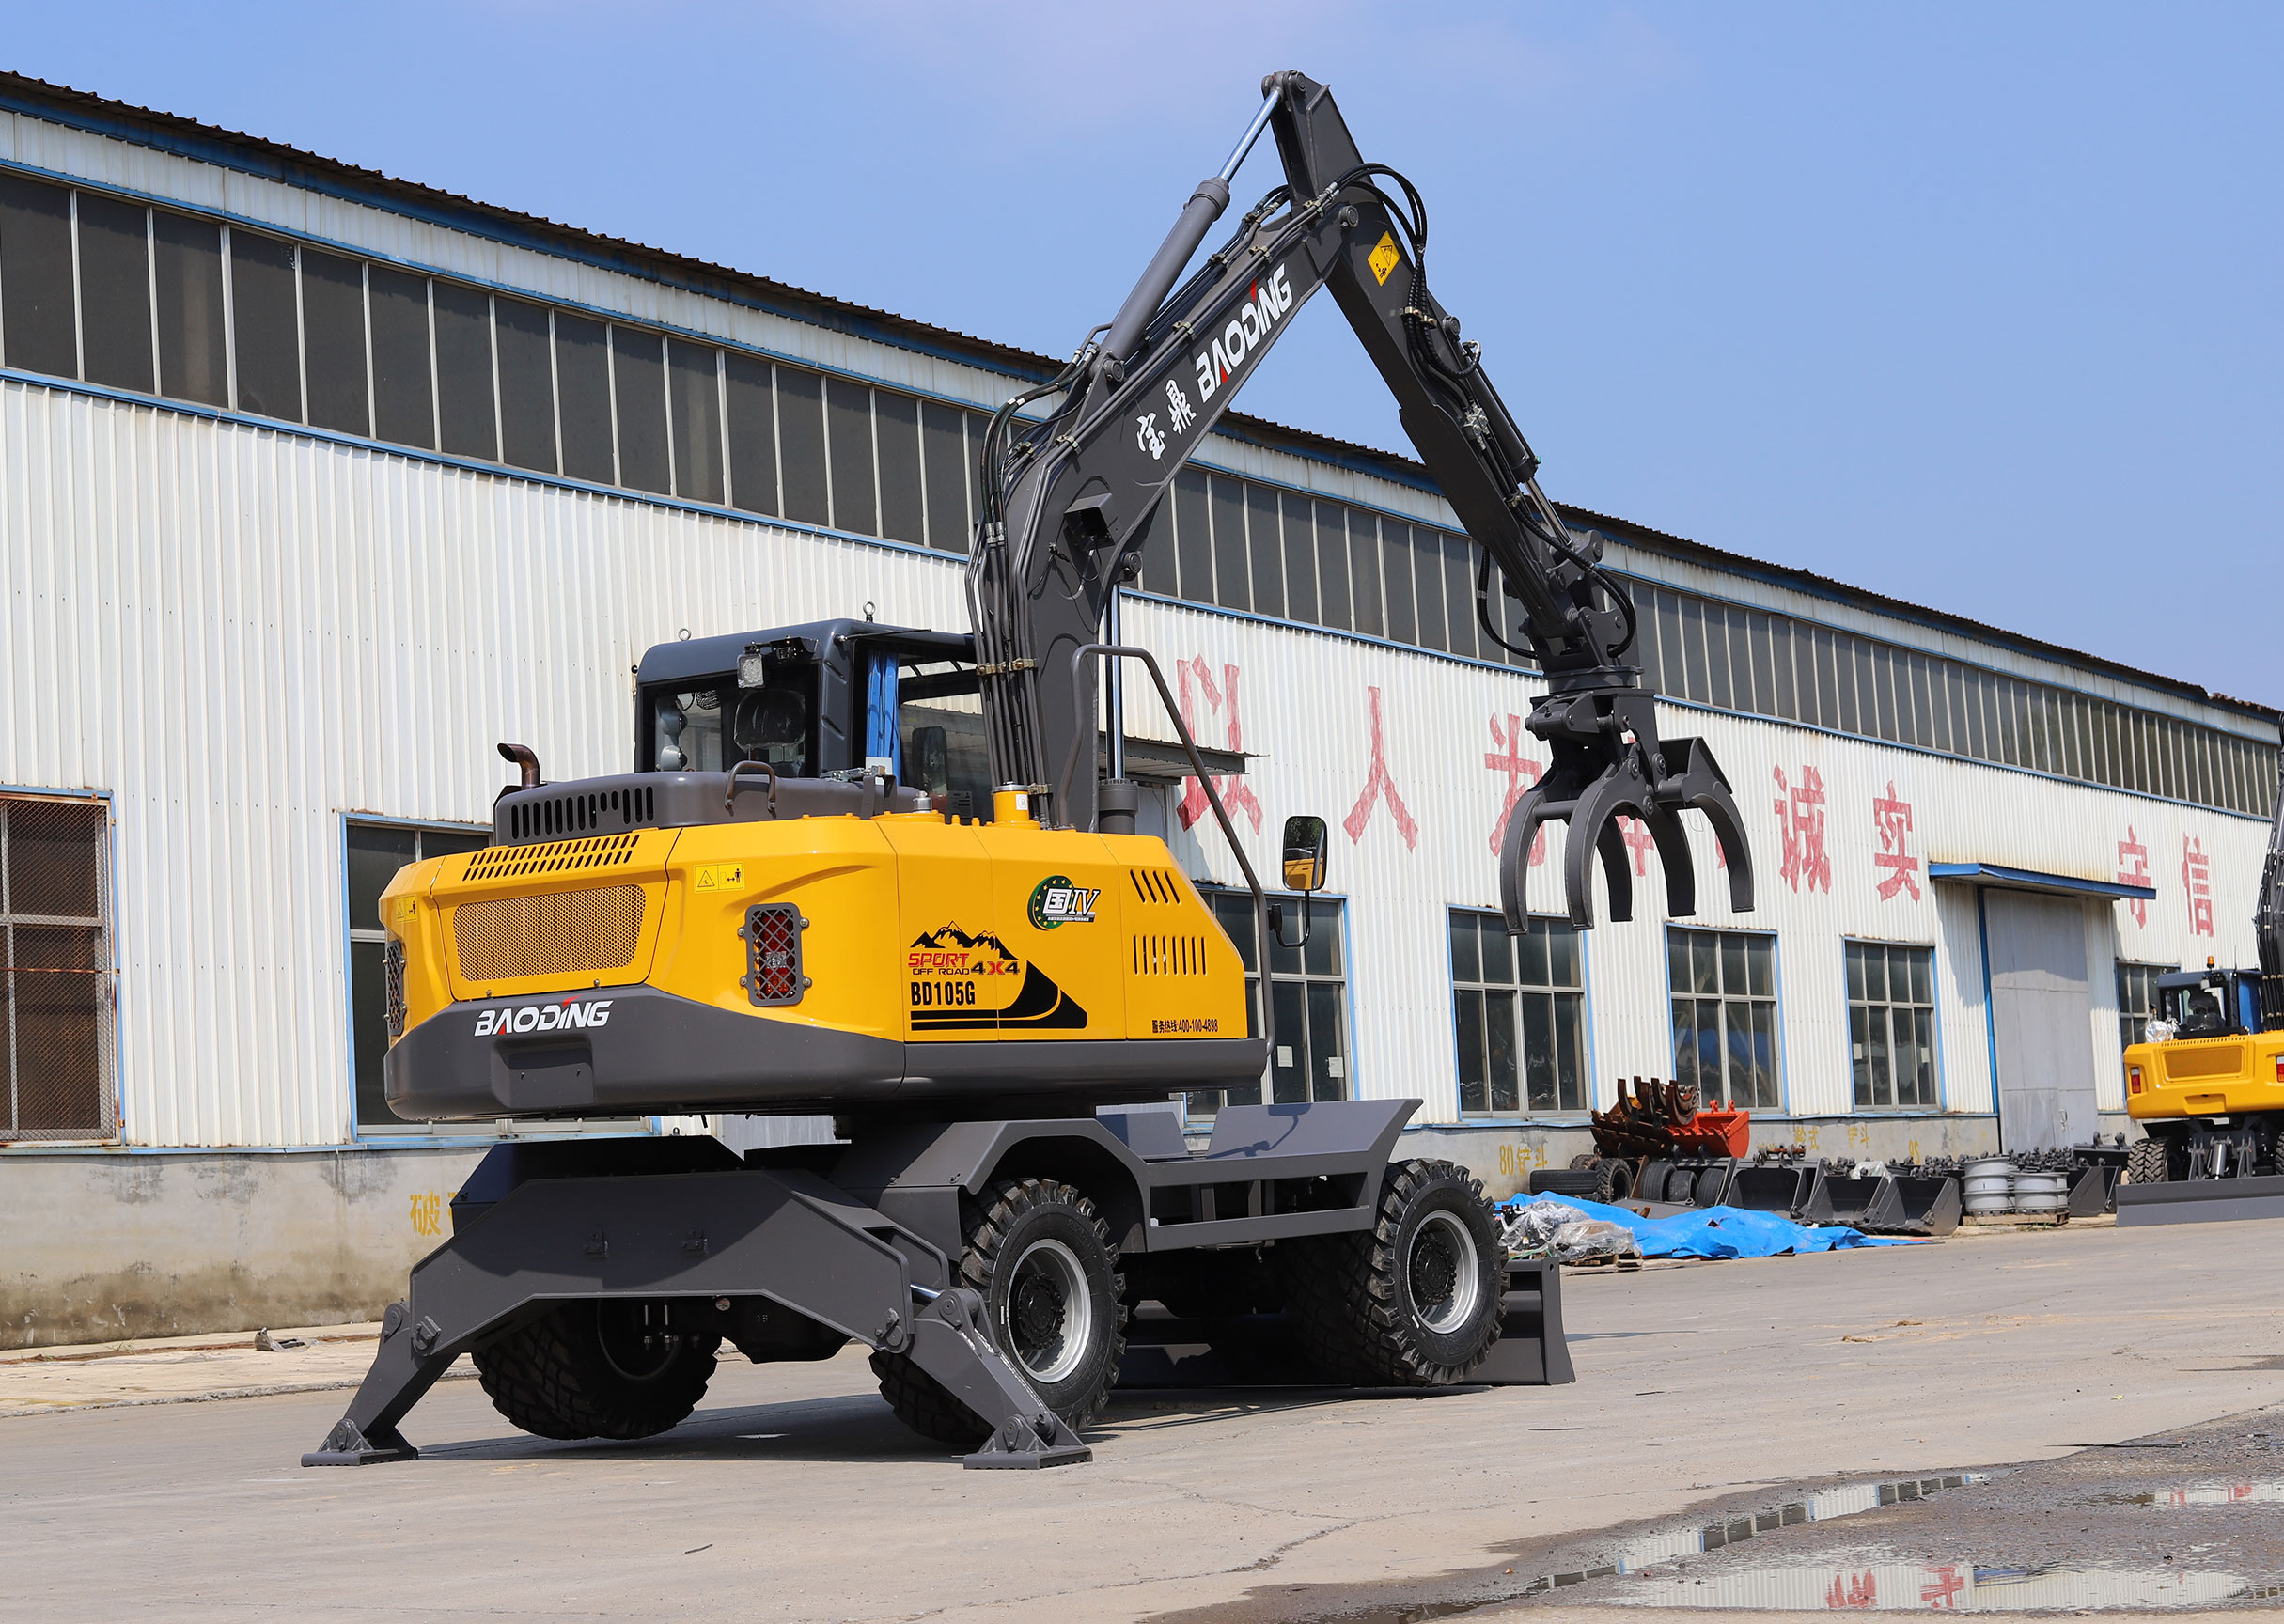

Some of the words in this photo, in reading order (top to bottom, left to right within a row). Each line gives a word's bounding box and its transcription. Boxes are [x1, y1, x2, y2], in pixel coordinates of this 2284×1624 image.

[1196, 263, 1293, 403] BAODING
[908, 953, 970, 967] SPORT
[910, 981, 976, 1006] BD105G
[474, 994, 614, 1037] BAODING
